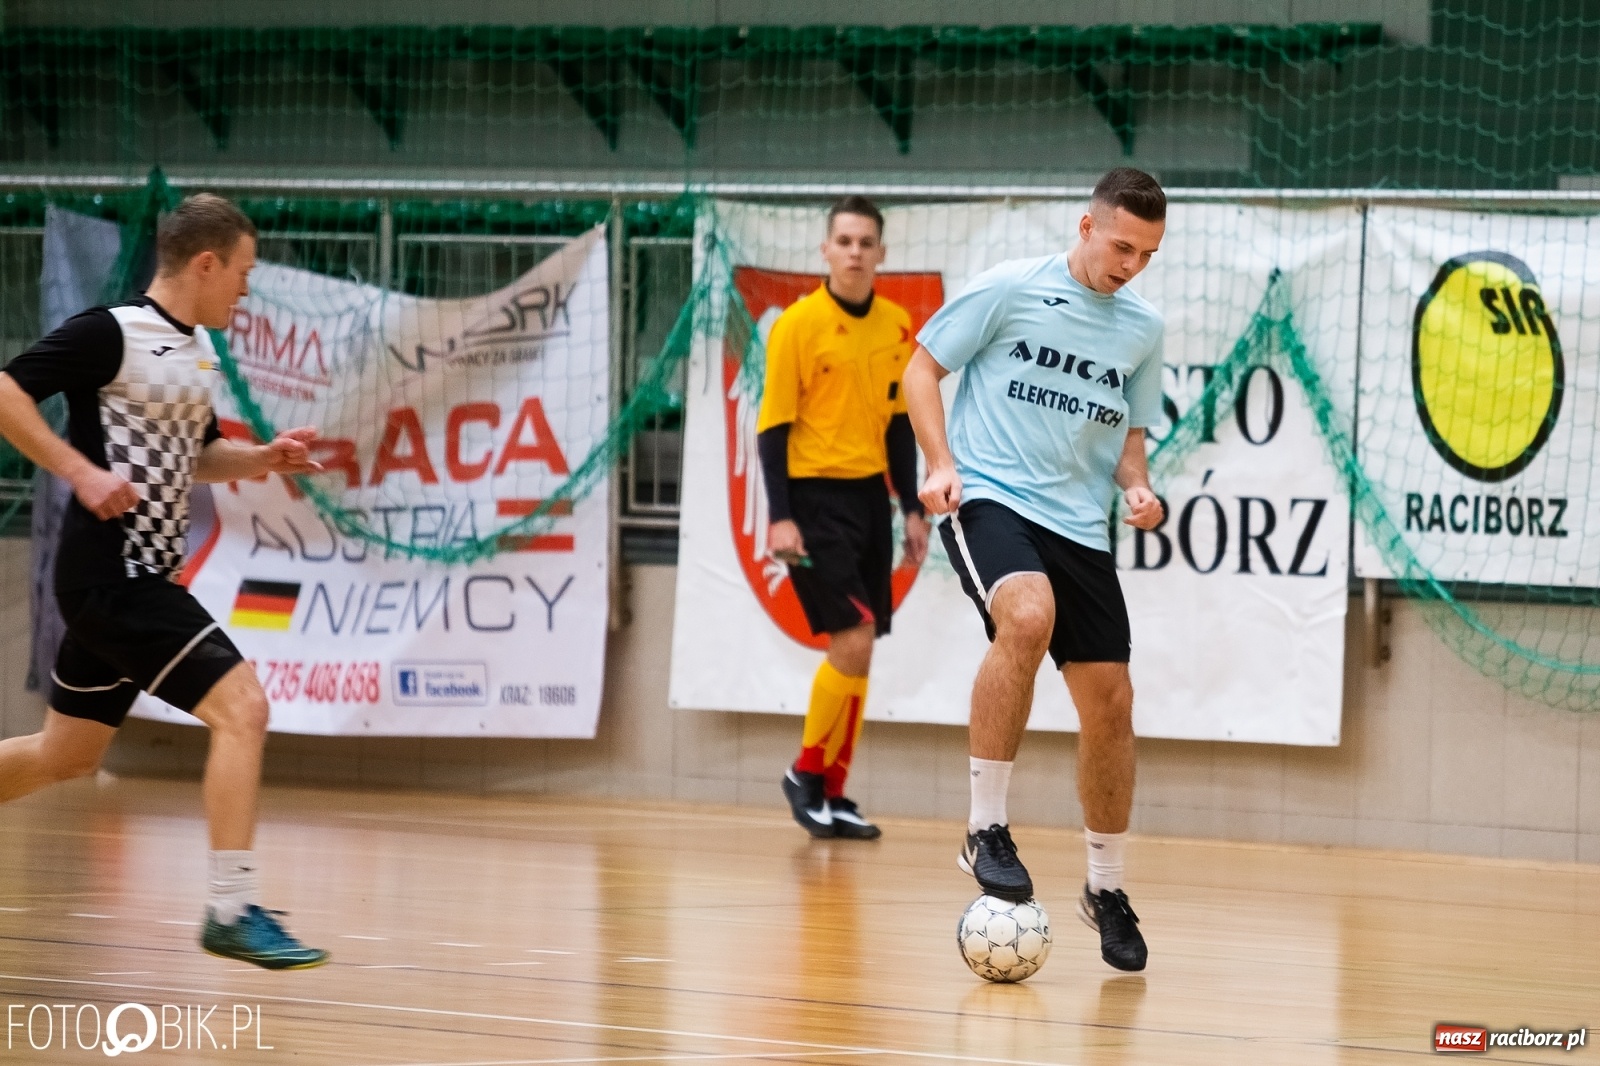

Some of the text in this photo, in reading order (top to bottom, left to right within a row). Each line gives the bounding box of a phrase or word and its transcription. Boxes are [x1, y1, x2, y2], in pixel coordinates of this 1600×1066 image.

[1009, 341, 1126, 390] ADICA
[1007, 380, 1124, 428] ELEKTRO-TECH
[216, 397, 570, 502] RACA
[250, 500, 479, 563] AUSTRIA
[1406, 487, 1568, 537] RACIBÓRZ
[301, 574, 575, 637] NIEMCY
[425, 681, 480, 697] facebook
